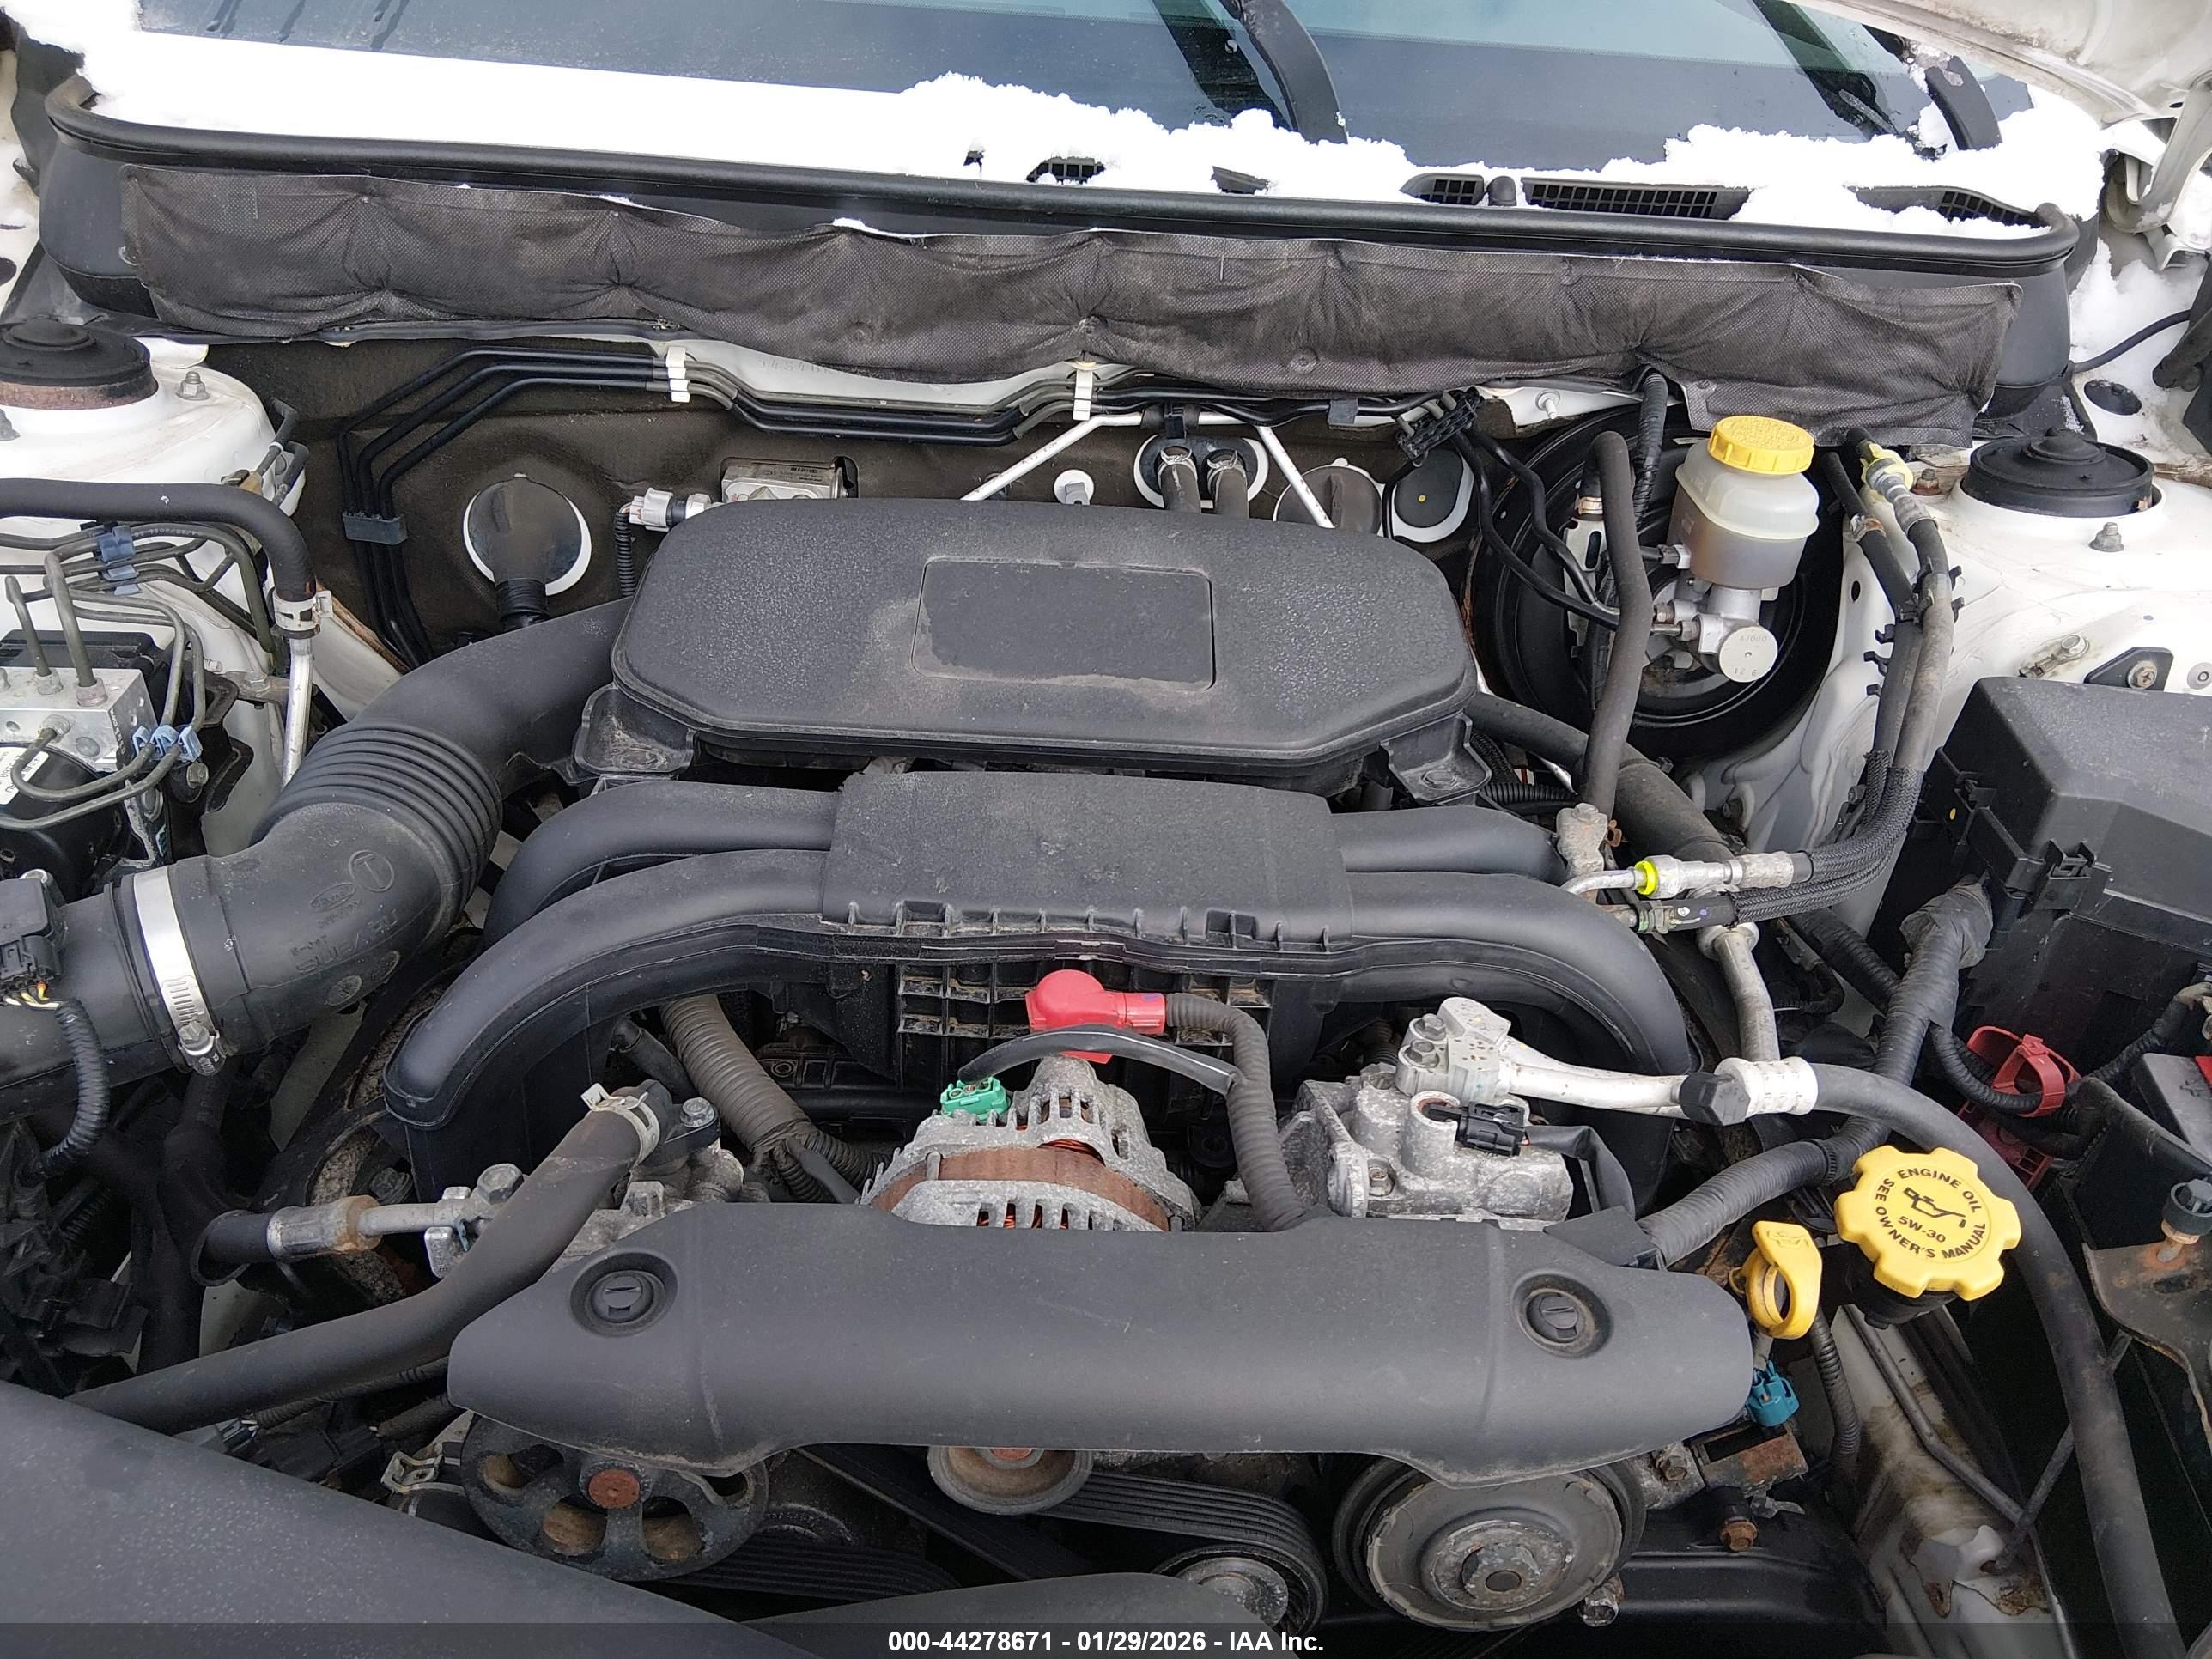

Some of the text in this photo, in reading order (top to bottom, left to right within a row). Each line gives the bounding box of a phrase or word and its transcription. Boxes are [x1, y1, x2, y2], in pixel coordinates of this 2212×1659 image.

[1897, 1167, 1982, 1213] ENGINE OIL
[1875, 1177, 1986, 1259] SEE OWNER'S MANUAL
[1898, 1216, 1946, 1243] 5W-30
